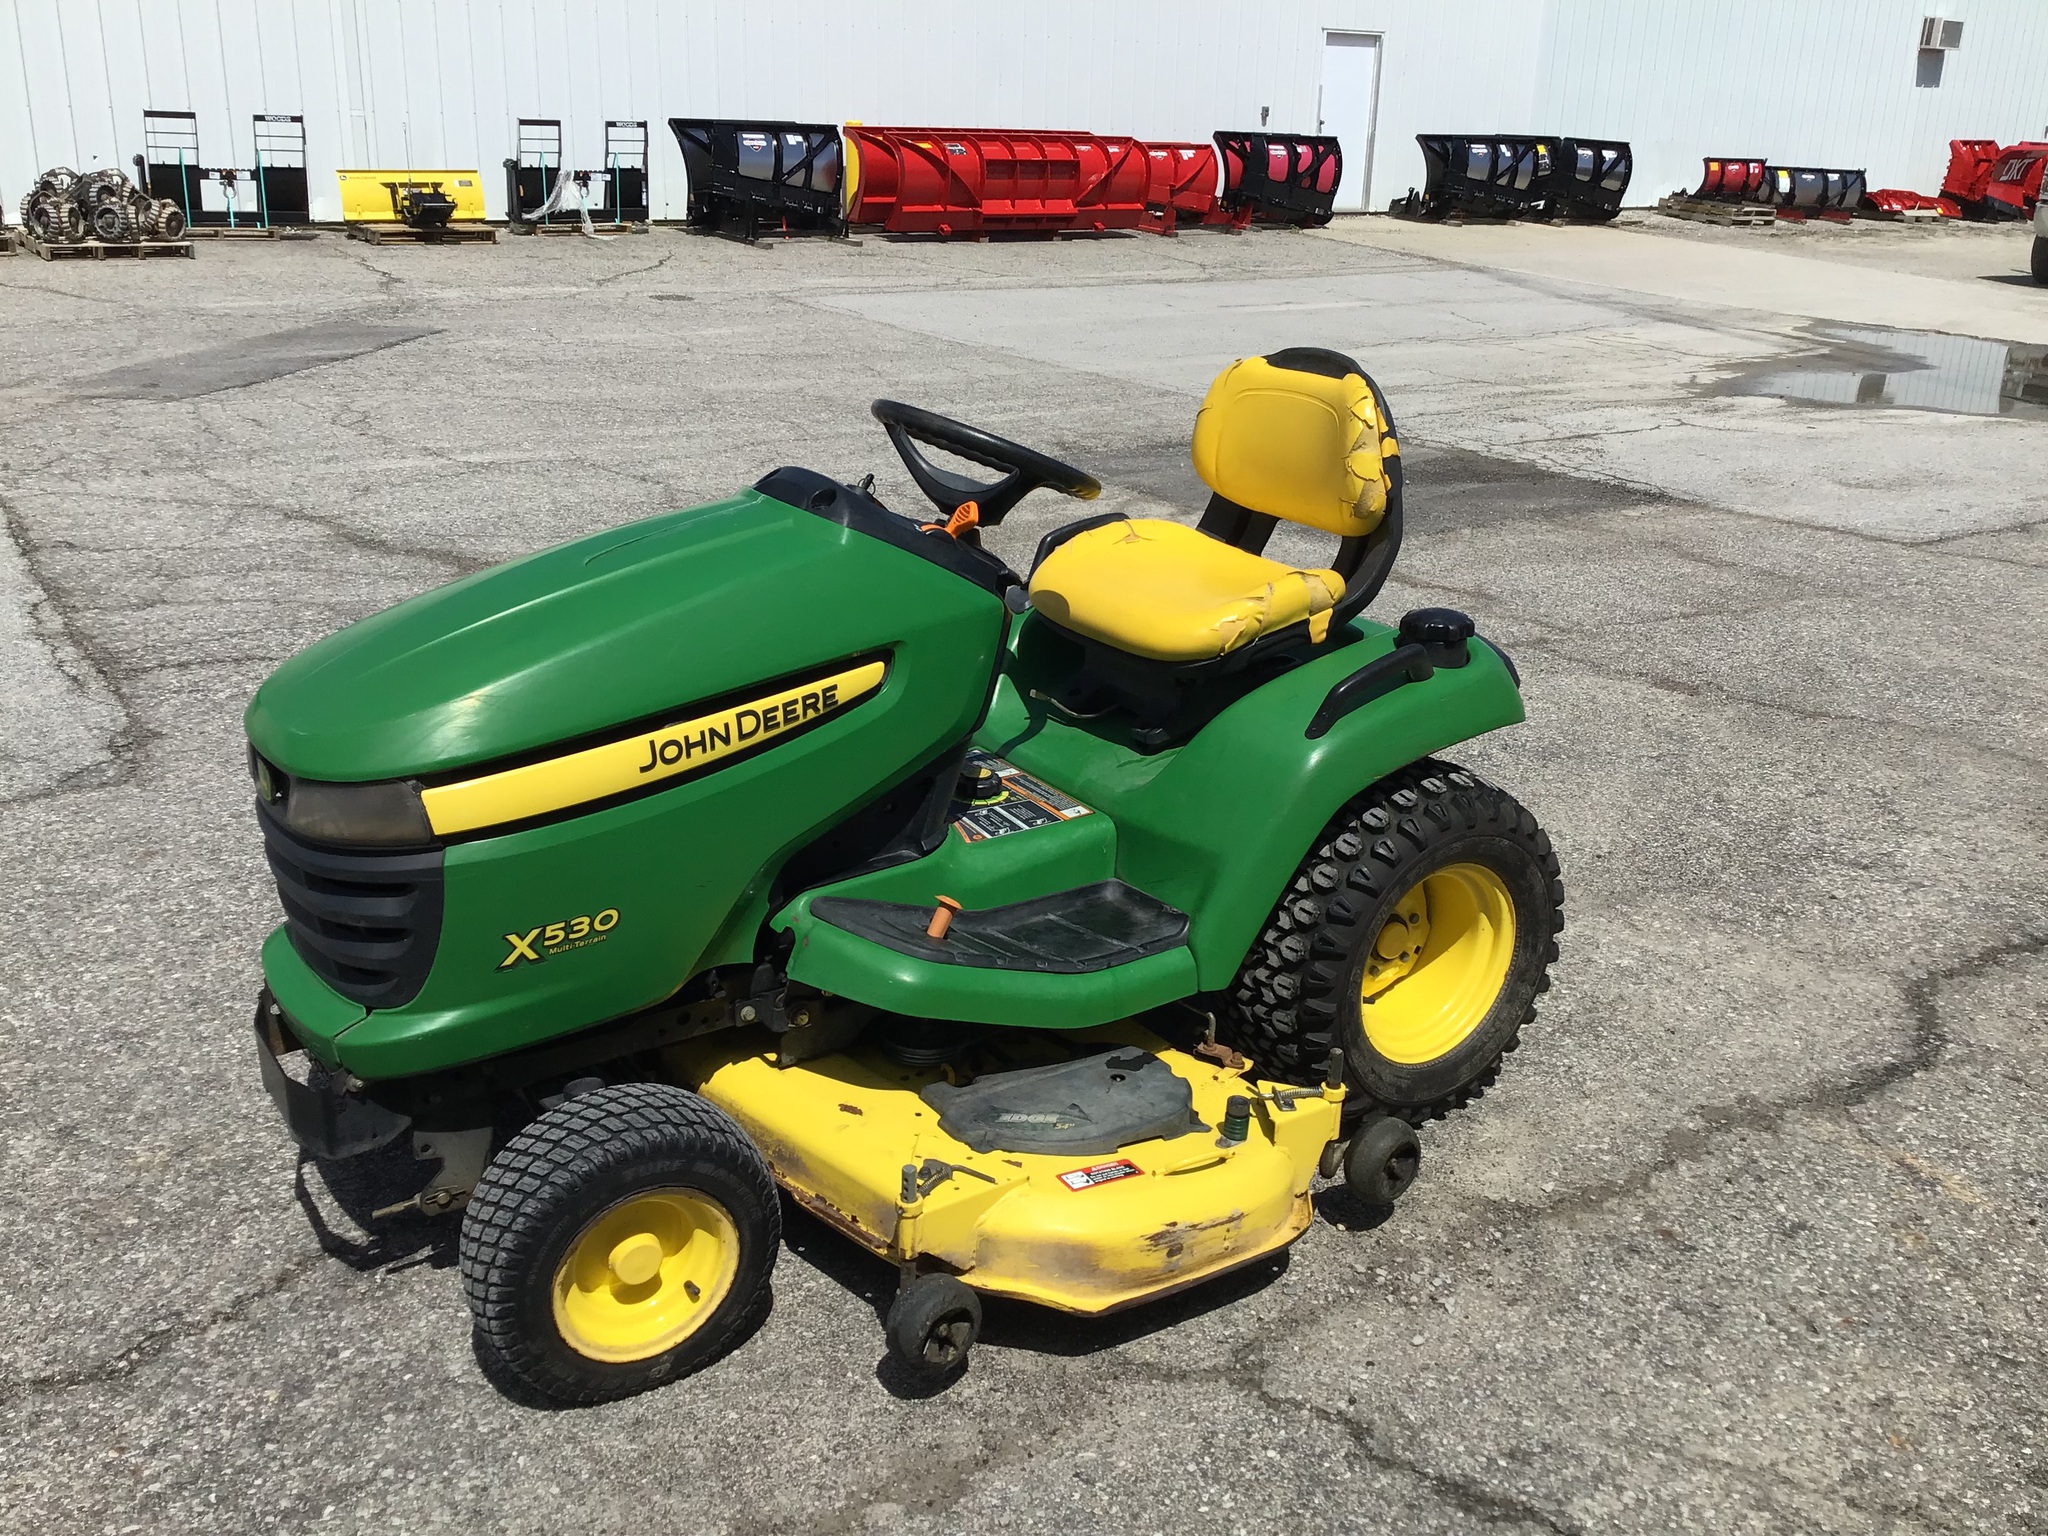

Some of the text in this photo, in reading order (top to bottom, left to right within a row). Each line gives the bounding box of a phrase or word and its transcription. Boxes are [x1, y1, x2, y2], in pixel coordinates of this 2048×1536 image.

[639, 683, 840, 774] JOHN DEERE
[497, 907, 620, 970] X530
[548, 934, 607, 955] Multi-Terrain
